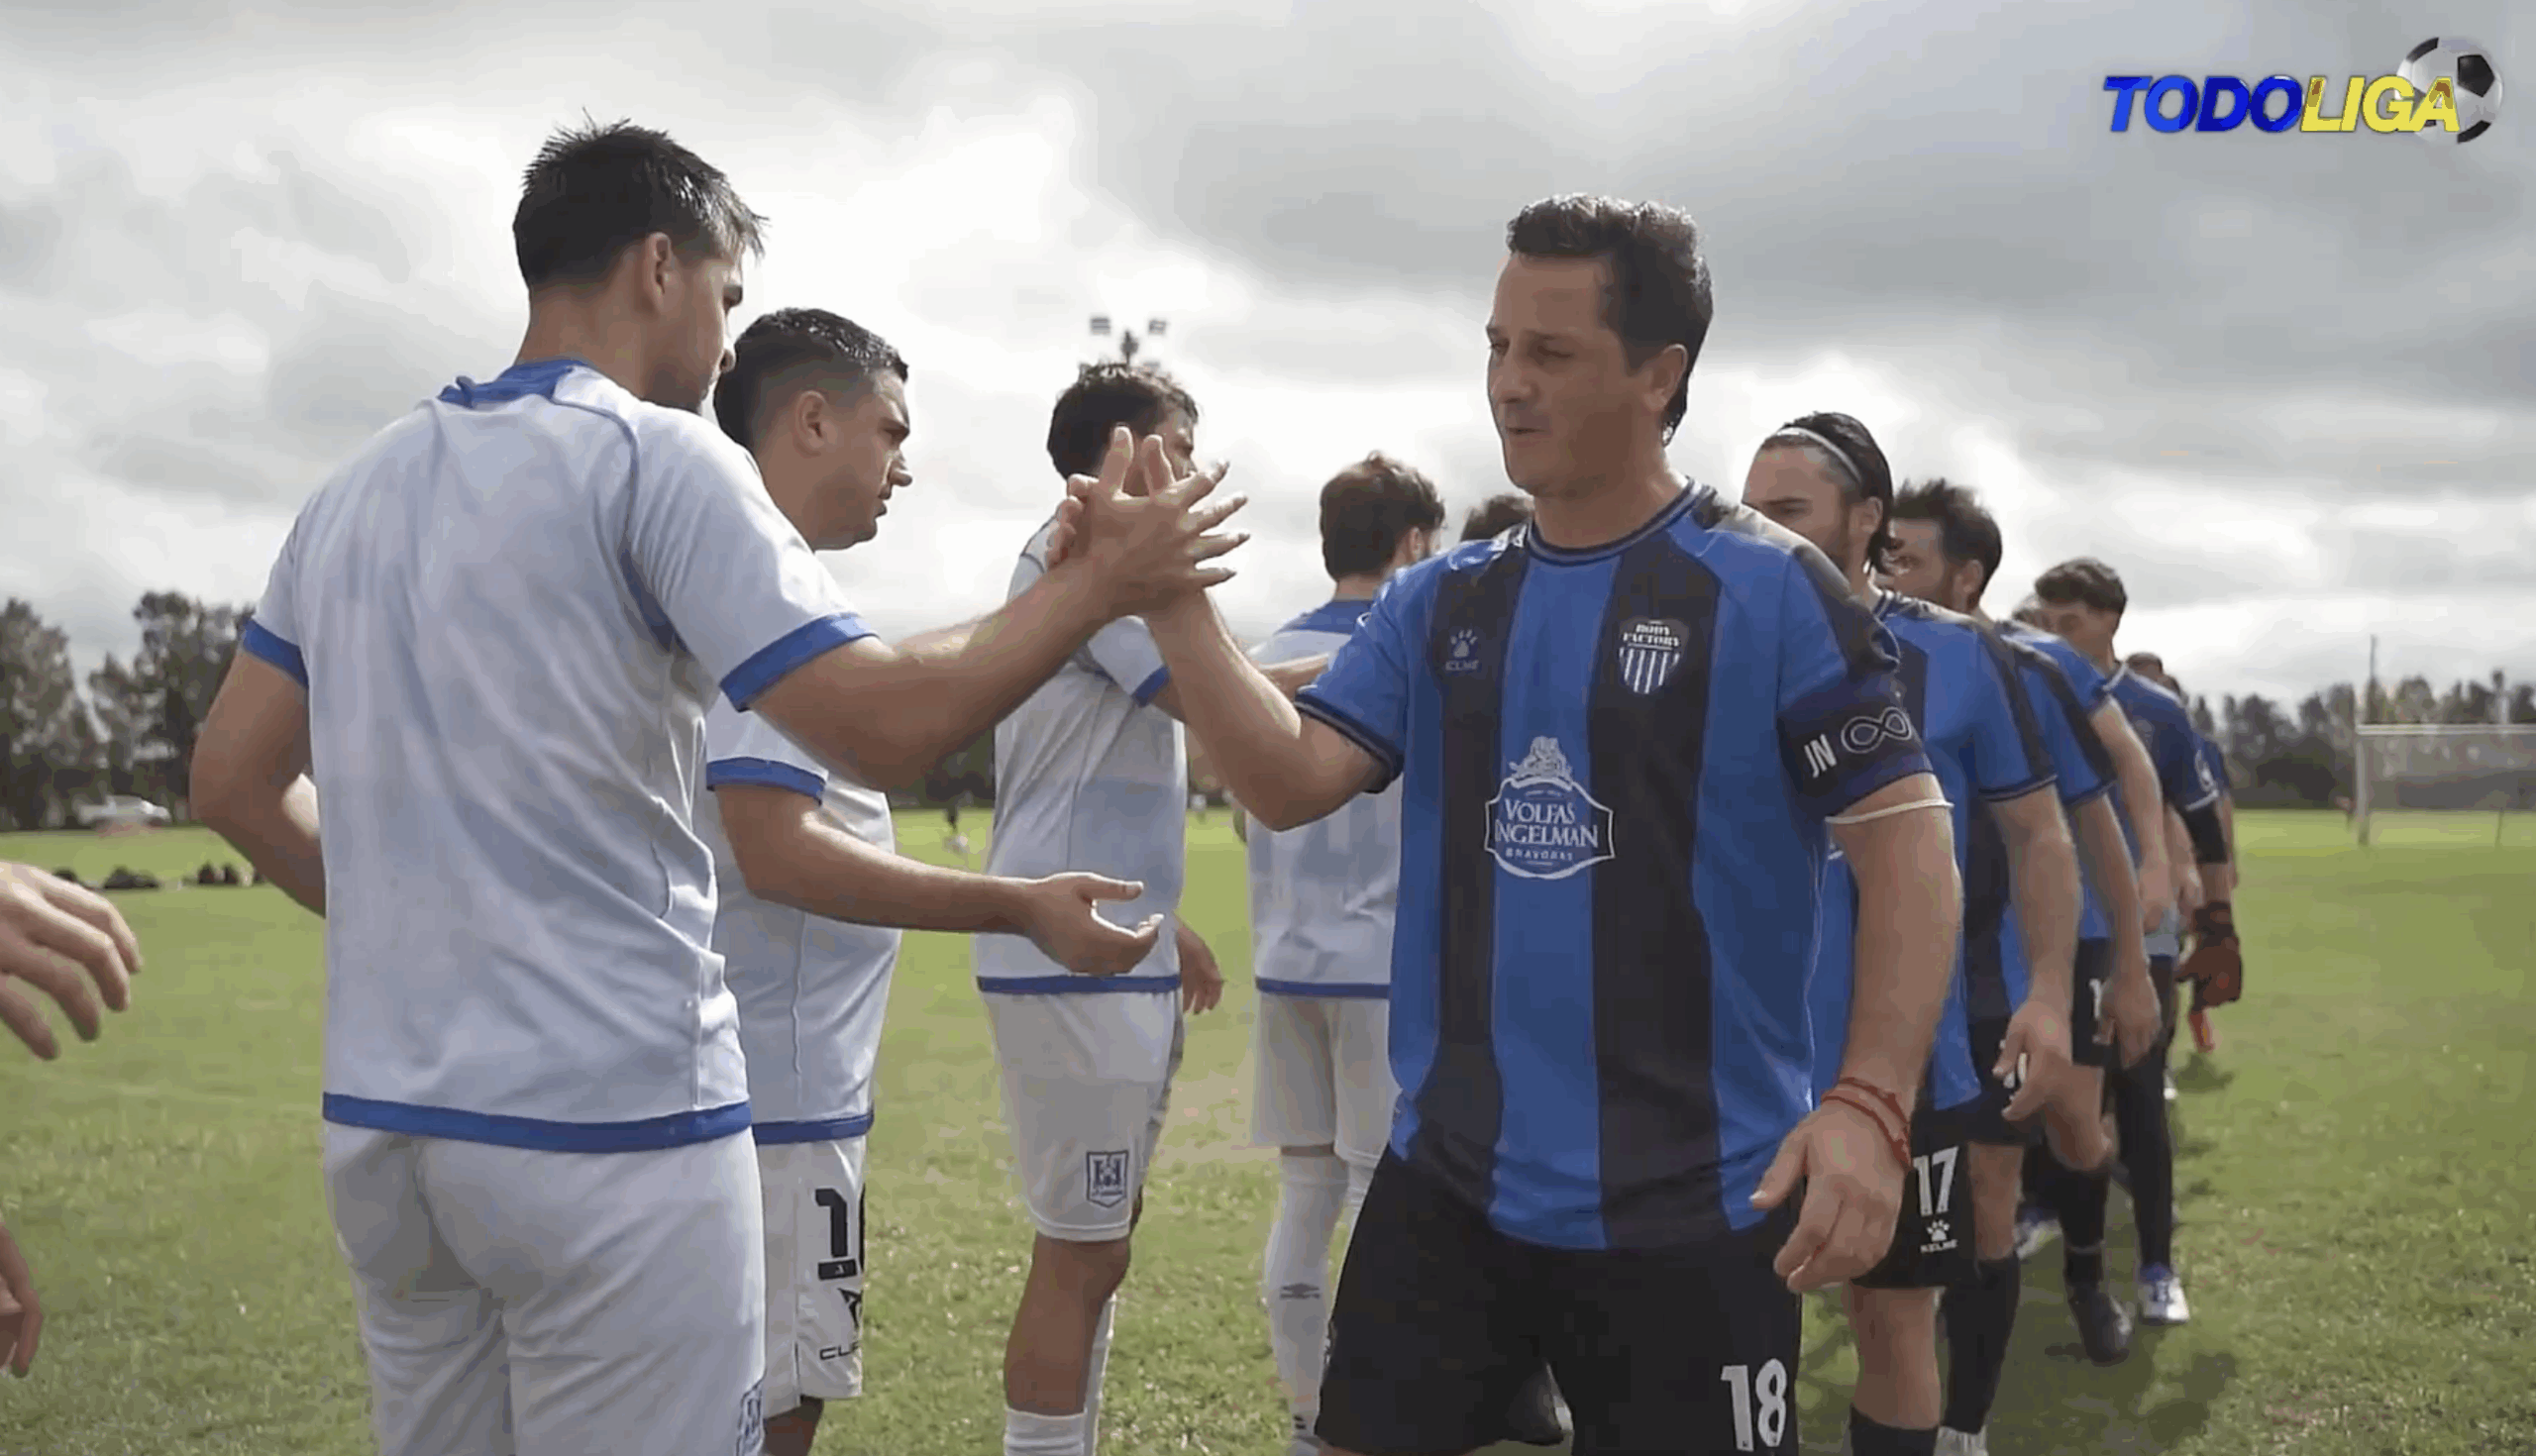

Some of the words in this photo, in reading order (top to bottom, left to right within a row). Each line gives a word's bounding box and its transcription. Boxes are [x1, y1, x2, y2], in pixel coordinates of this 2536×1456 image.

[1803, 733, 1838, 779] JN
[1504, 798, 1576, 825] VOLFAS
[1913, 1146, 1959, 1216] 17
[1720, 1358, 1787, 1452] 18
